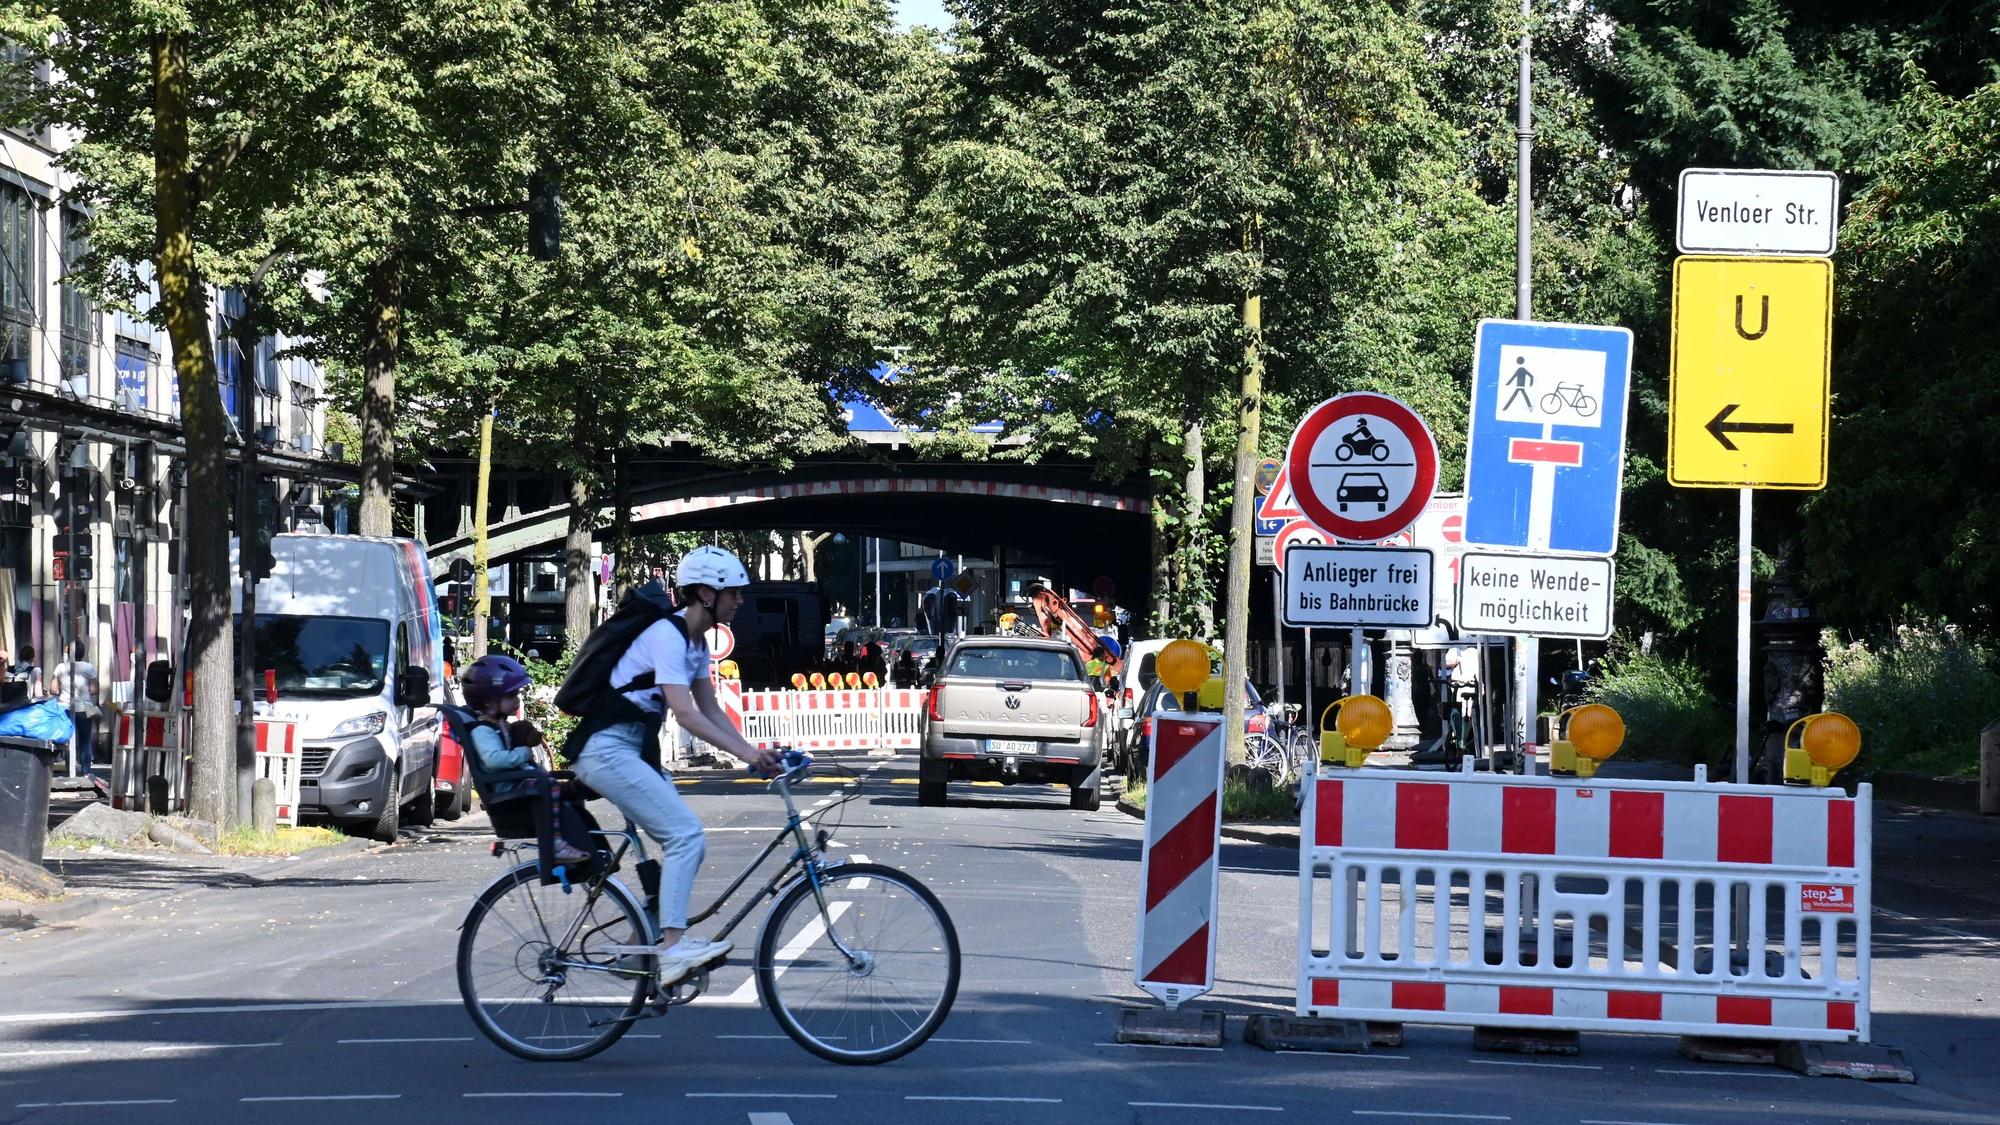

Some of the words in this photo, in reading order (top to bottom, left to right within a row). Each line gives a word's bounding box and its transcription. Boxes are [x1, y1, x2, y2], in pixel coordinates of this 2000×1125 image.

[1697, 199, 1773, 224] Venloer
[1785, 202, 1818, 225] Str.
[1735, 295, 1769, 340] U
[1303, 561, 1377, 588] Anlieger
[1387, 563, 1418, 584] frei
[1470, 566, 1519, 588] keine
[1530, 569, 1601, 592] Wende-
[1300, 592, 1322, 610] bis
[1330, 592, 1419, 612] Bahnbrücke
[1480, 597, 1588, 624] möglichkeit
[958, 710, 1071, 724] AMAROK
[1802, 888, 1827, 901] step
